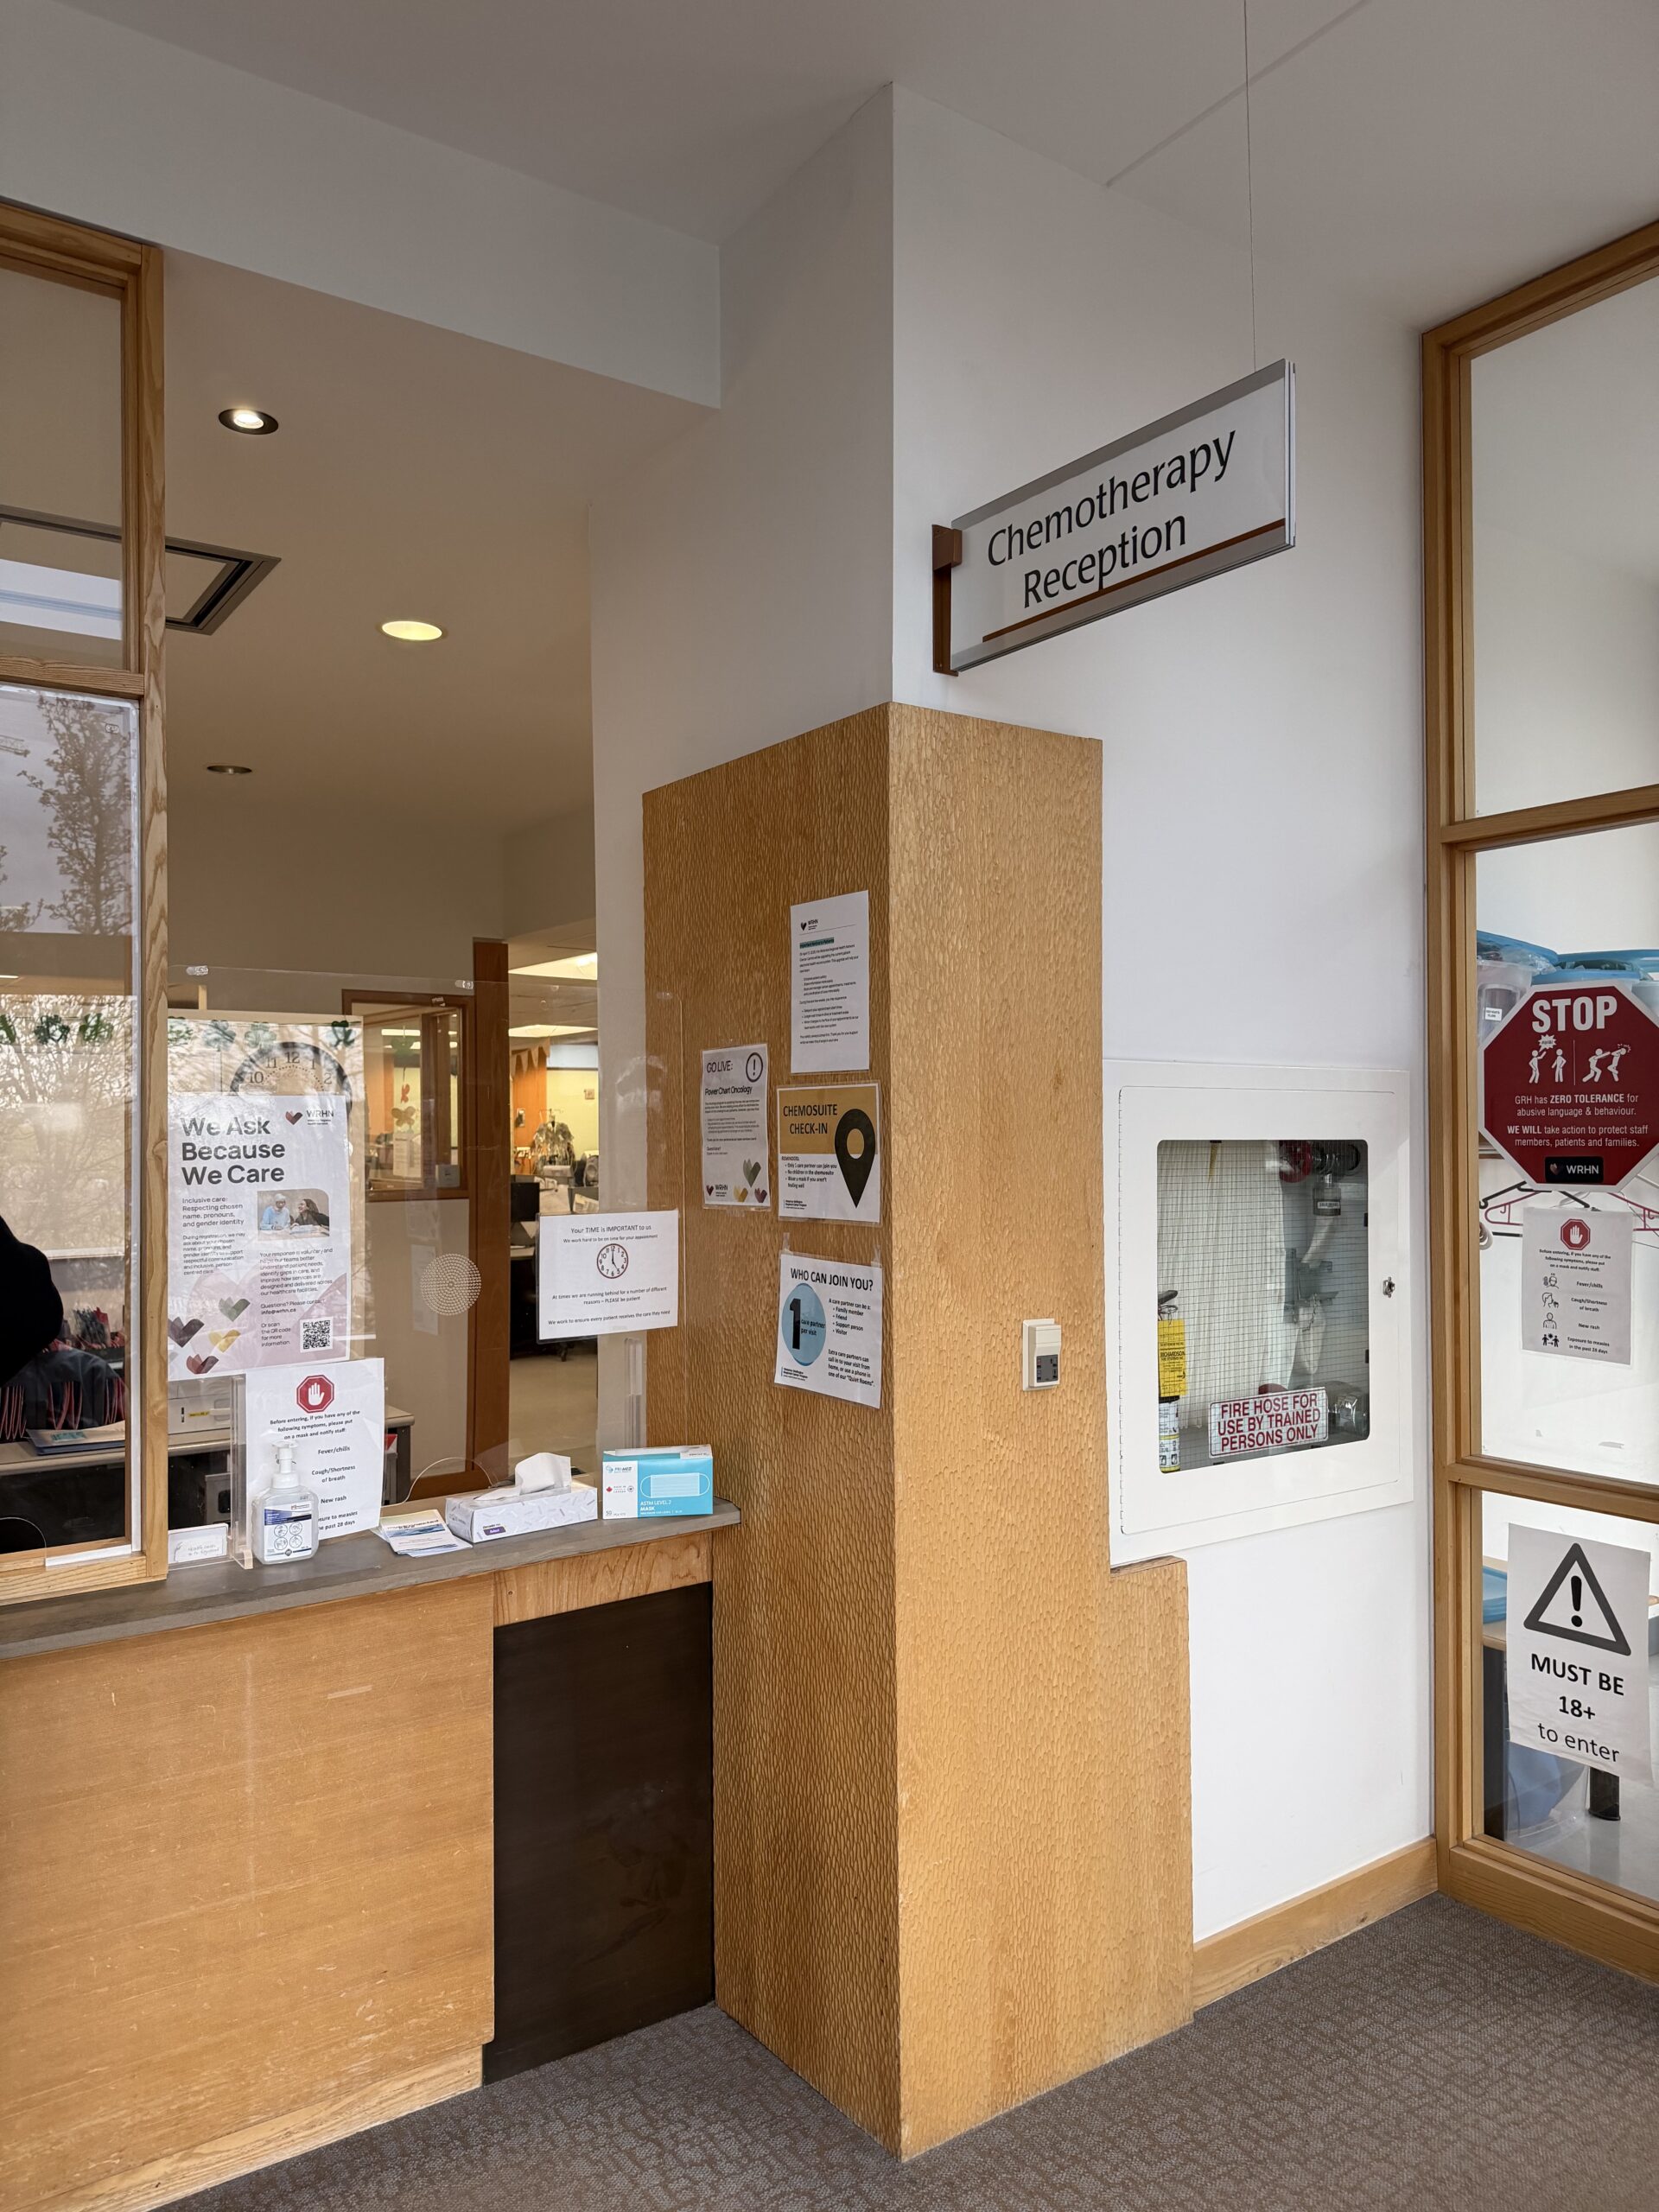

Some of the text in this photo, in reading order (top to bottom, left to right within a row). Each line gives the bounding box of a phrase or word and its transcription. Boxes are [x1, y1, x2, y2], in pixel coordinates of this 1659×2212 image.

[987, 429, 1236, 566] Chemotherapy
[1023, 515, 1186, 609] Reception
[1532, 995, 1618, 1033] STOP
[285, 1051, 300, 1064] 12
[706, 1060, 733, 1073] GO LIVE:
[249, 1071, 264, 1083] 10
[1515, 1094, 1639, 1104] GRH has ZERO TOLERANCE for
[783, 1104, 837, 1116] CHEMOSUITE
[1517, 1107, 1636, 1117] abusive language & behaviour.
[181, 1118, 271, 1136] We Ask
[790, 1123, 828, 1134] CHECK-IN
[1507, 1126, 1520, 1134] WE
[1522, 1126, 1542, 1134] WILL
[1544, 1126, 1560, 1134] take
[1588, 1126, 1596, 1134] to
[1599, 1126, 1627, 1135] protect
[1630, 1125, 1648, 1134] staff
[1555, 1138, 1585, 1147] patients
[1588, 1138, 1602, 1146] and
[1605, 1138, 1639, 1146] families.
[182, 1143, 285, 1161] Because
[181, 1166, 285, 1185] We Care
[1566, 1165, 1599, 1174] WRHN
[791, 1268, 873, 1291] WHO CAN JOIN YOU?
[790, 1298, 801, 1350] 1
[1221, 1393, 1317, 1418] FIRE HOSE FOR
[1218, 1409, 1320, 1435] USE BY TRAINED
[1222, 1424, 1318, 1451] PERSONS ONLY
[318, 1446, 350, 1455] Fever/chills
[311, 1466, 356, 1475] Cough/Shortness
[1532, 1654, 1624, 1696] MUST BE
[1559, 1696, 1596, 1719] 18+
[1538, 1723, 1620, 1762] to enter
